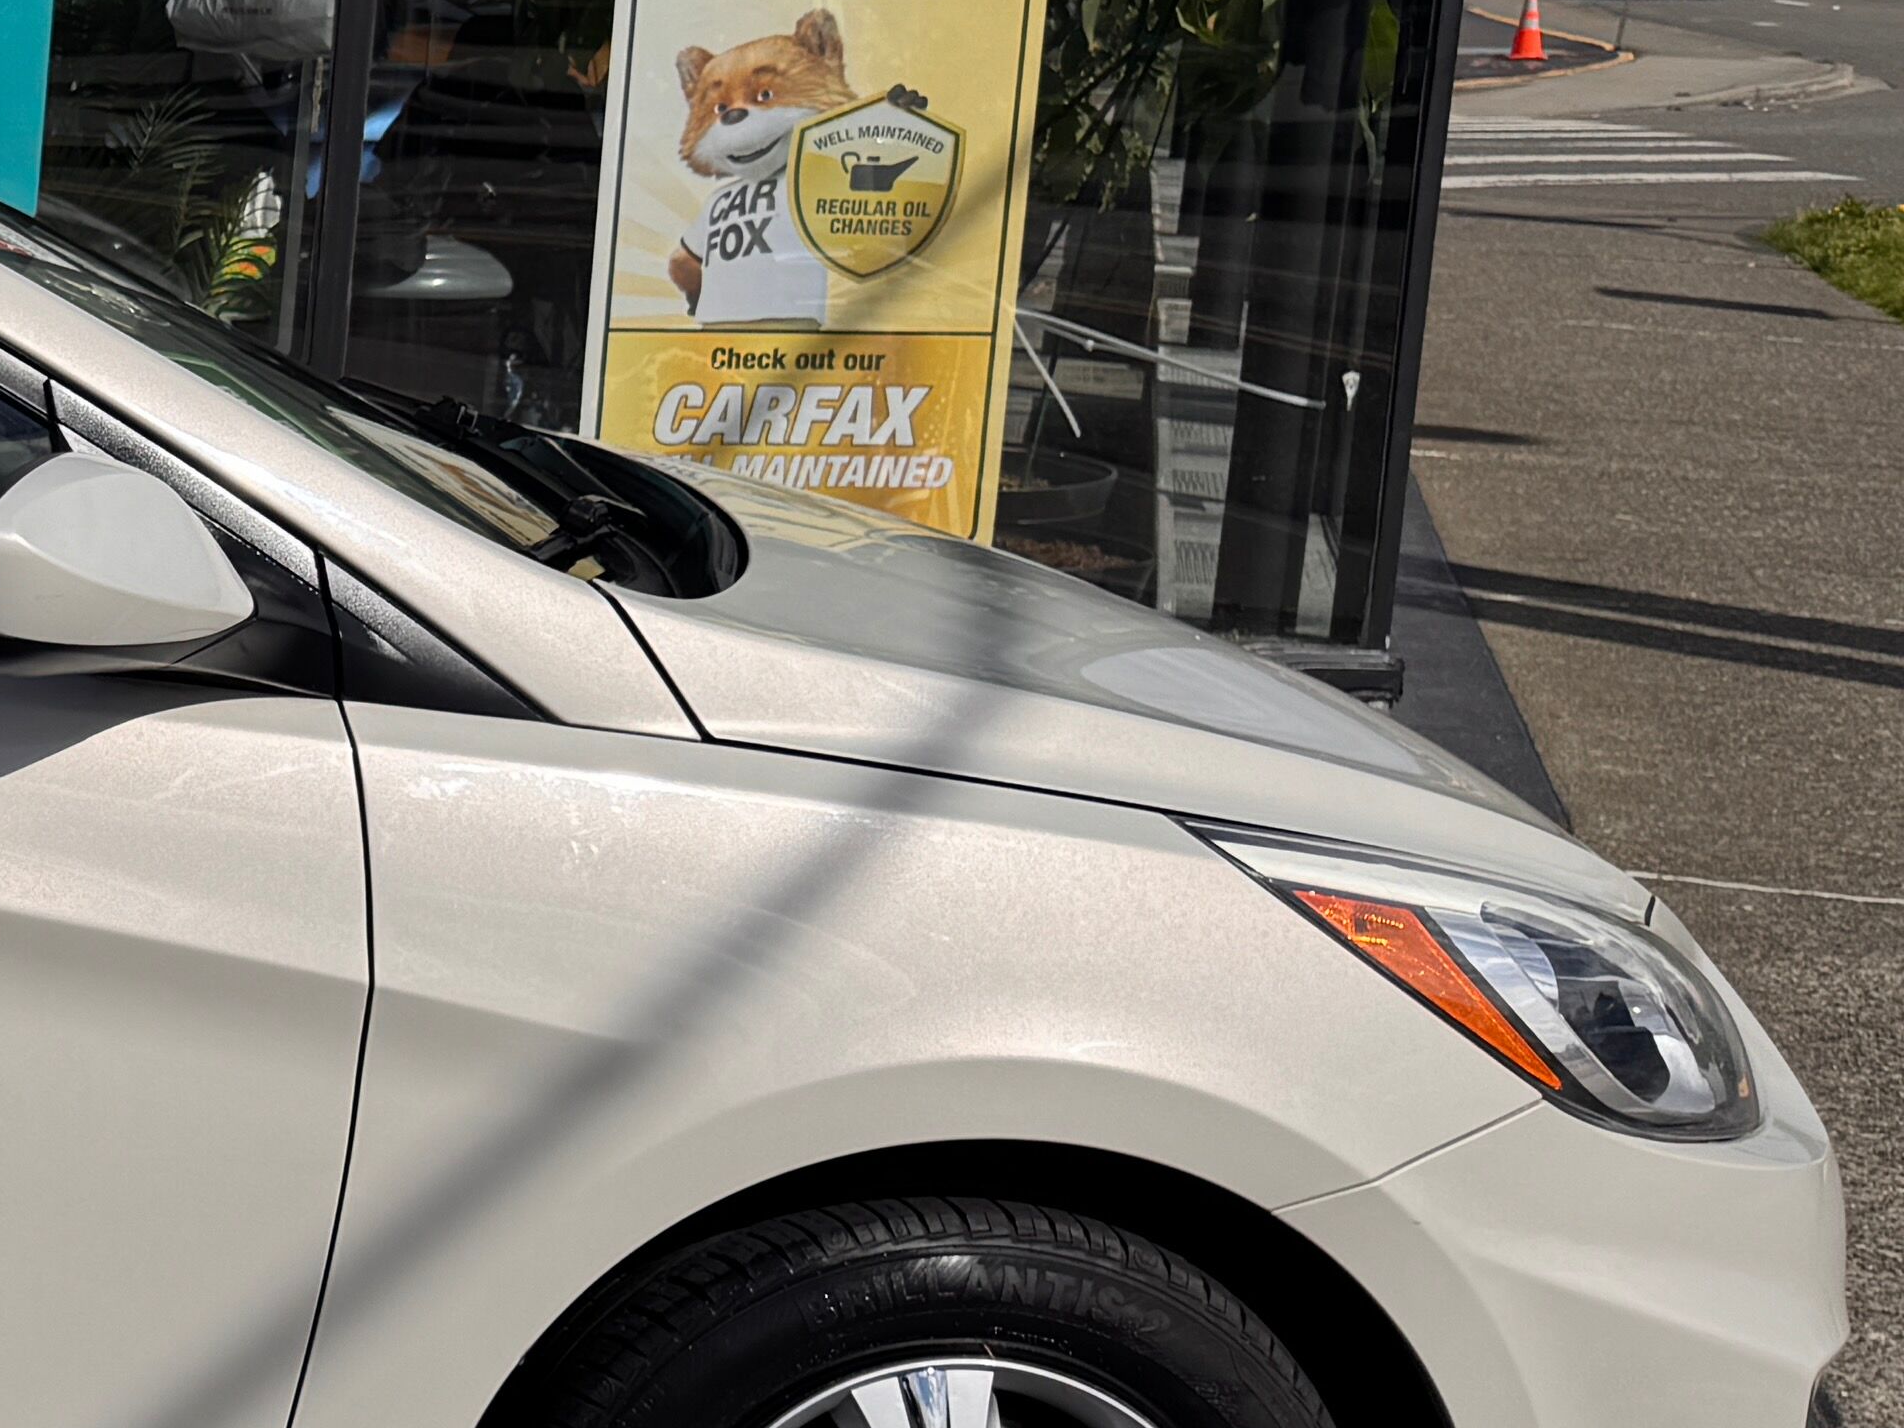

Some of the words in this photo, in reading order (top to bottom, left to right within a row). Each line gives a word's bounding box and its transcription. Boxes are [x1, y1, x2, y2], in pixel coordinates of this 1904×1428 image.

[813, 128, 854, 151] WELL
[858, 125, 945, 154] MAINTAINED
[709, 178, 777, 227] CAR
[816, 198, 898, 218] REGULAR
[903, 200, 931, 218] OIL
[704, 217, 773, 267] FOX
[830, 218, 912, 237] CHANGES
[711, 347, 786, 370] Check
[795, 349, 835, 370] out
[844, 353, 885, 371] our
[653, 383, 932, 447] CARFAX
